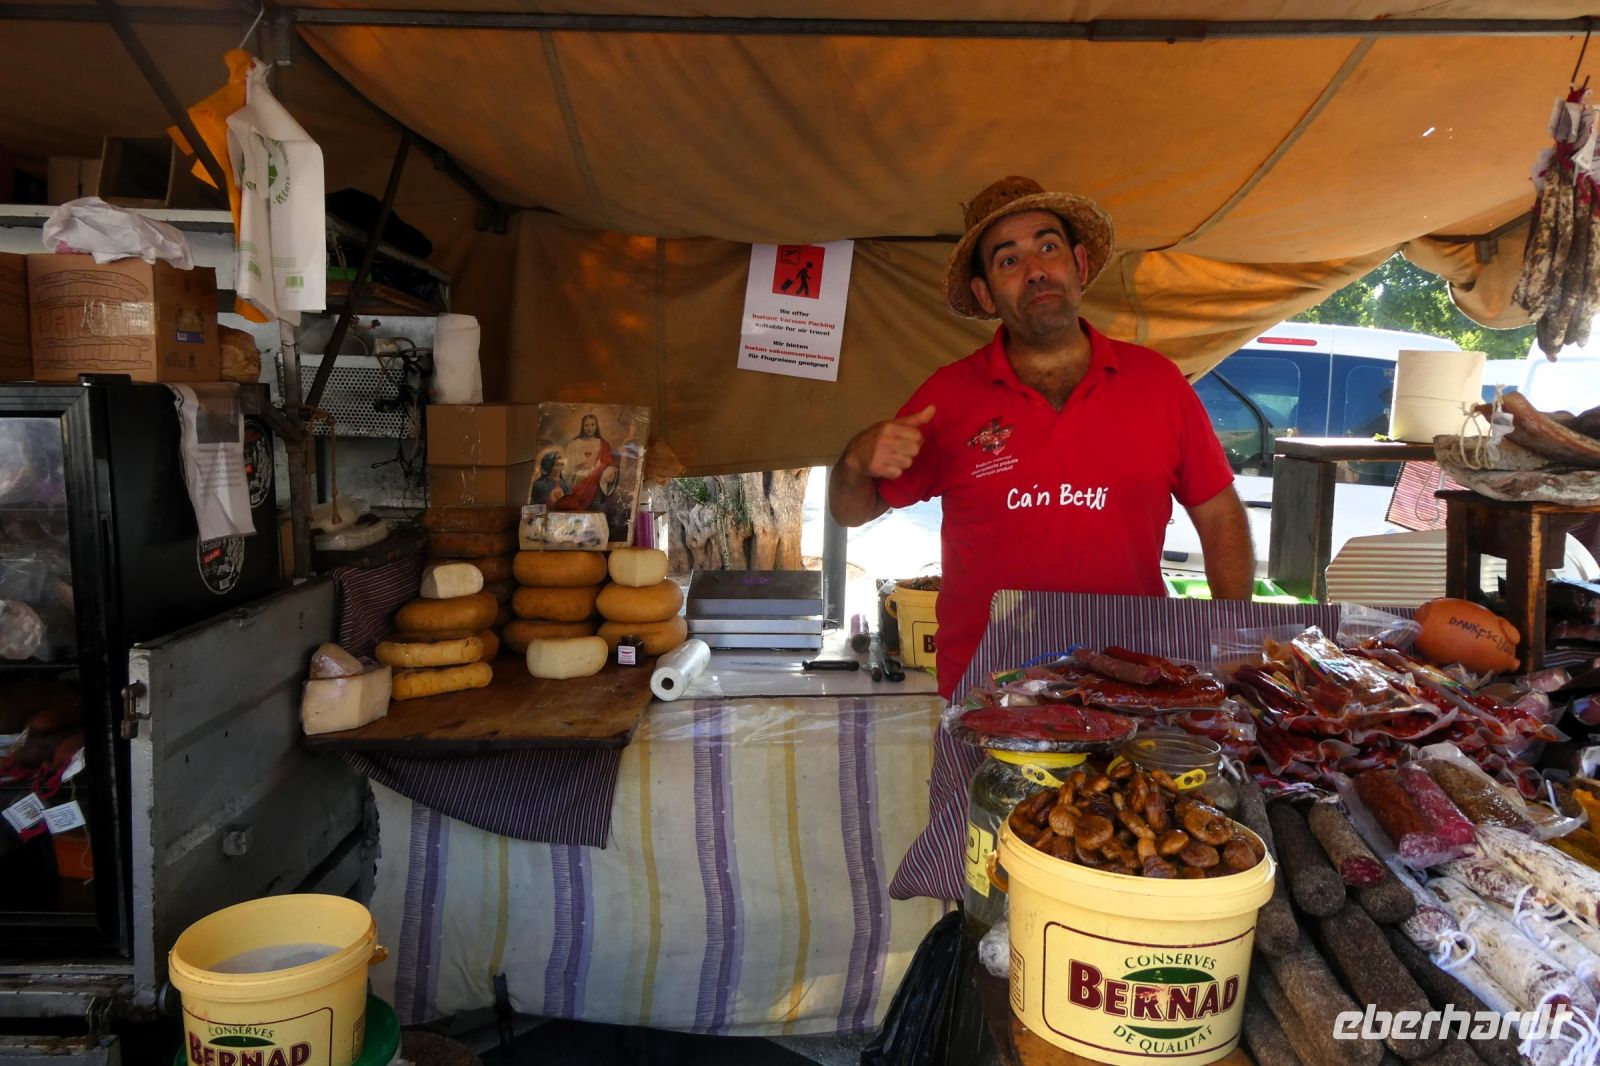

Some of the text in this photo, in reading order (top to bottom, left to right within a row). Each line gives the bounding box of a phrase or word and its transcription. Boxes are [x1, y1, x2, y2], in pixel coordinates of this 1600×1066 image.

[752, 313, 777, 321] Instant
[808, 320, 835, 329] Packing
[761, 354, 796, 364] Flugreisen
[798, 359, 828, 368] geeignet
[1124, 953, 1217, 971] CONSERVES
[1067, 958, 1240, 1022] BERNAD
[208, 1025, 275, 1039] CONSERVES
[1113, 1025, 1136, 1045] DE
[188, 1030, 312, 1066] BERNAD
